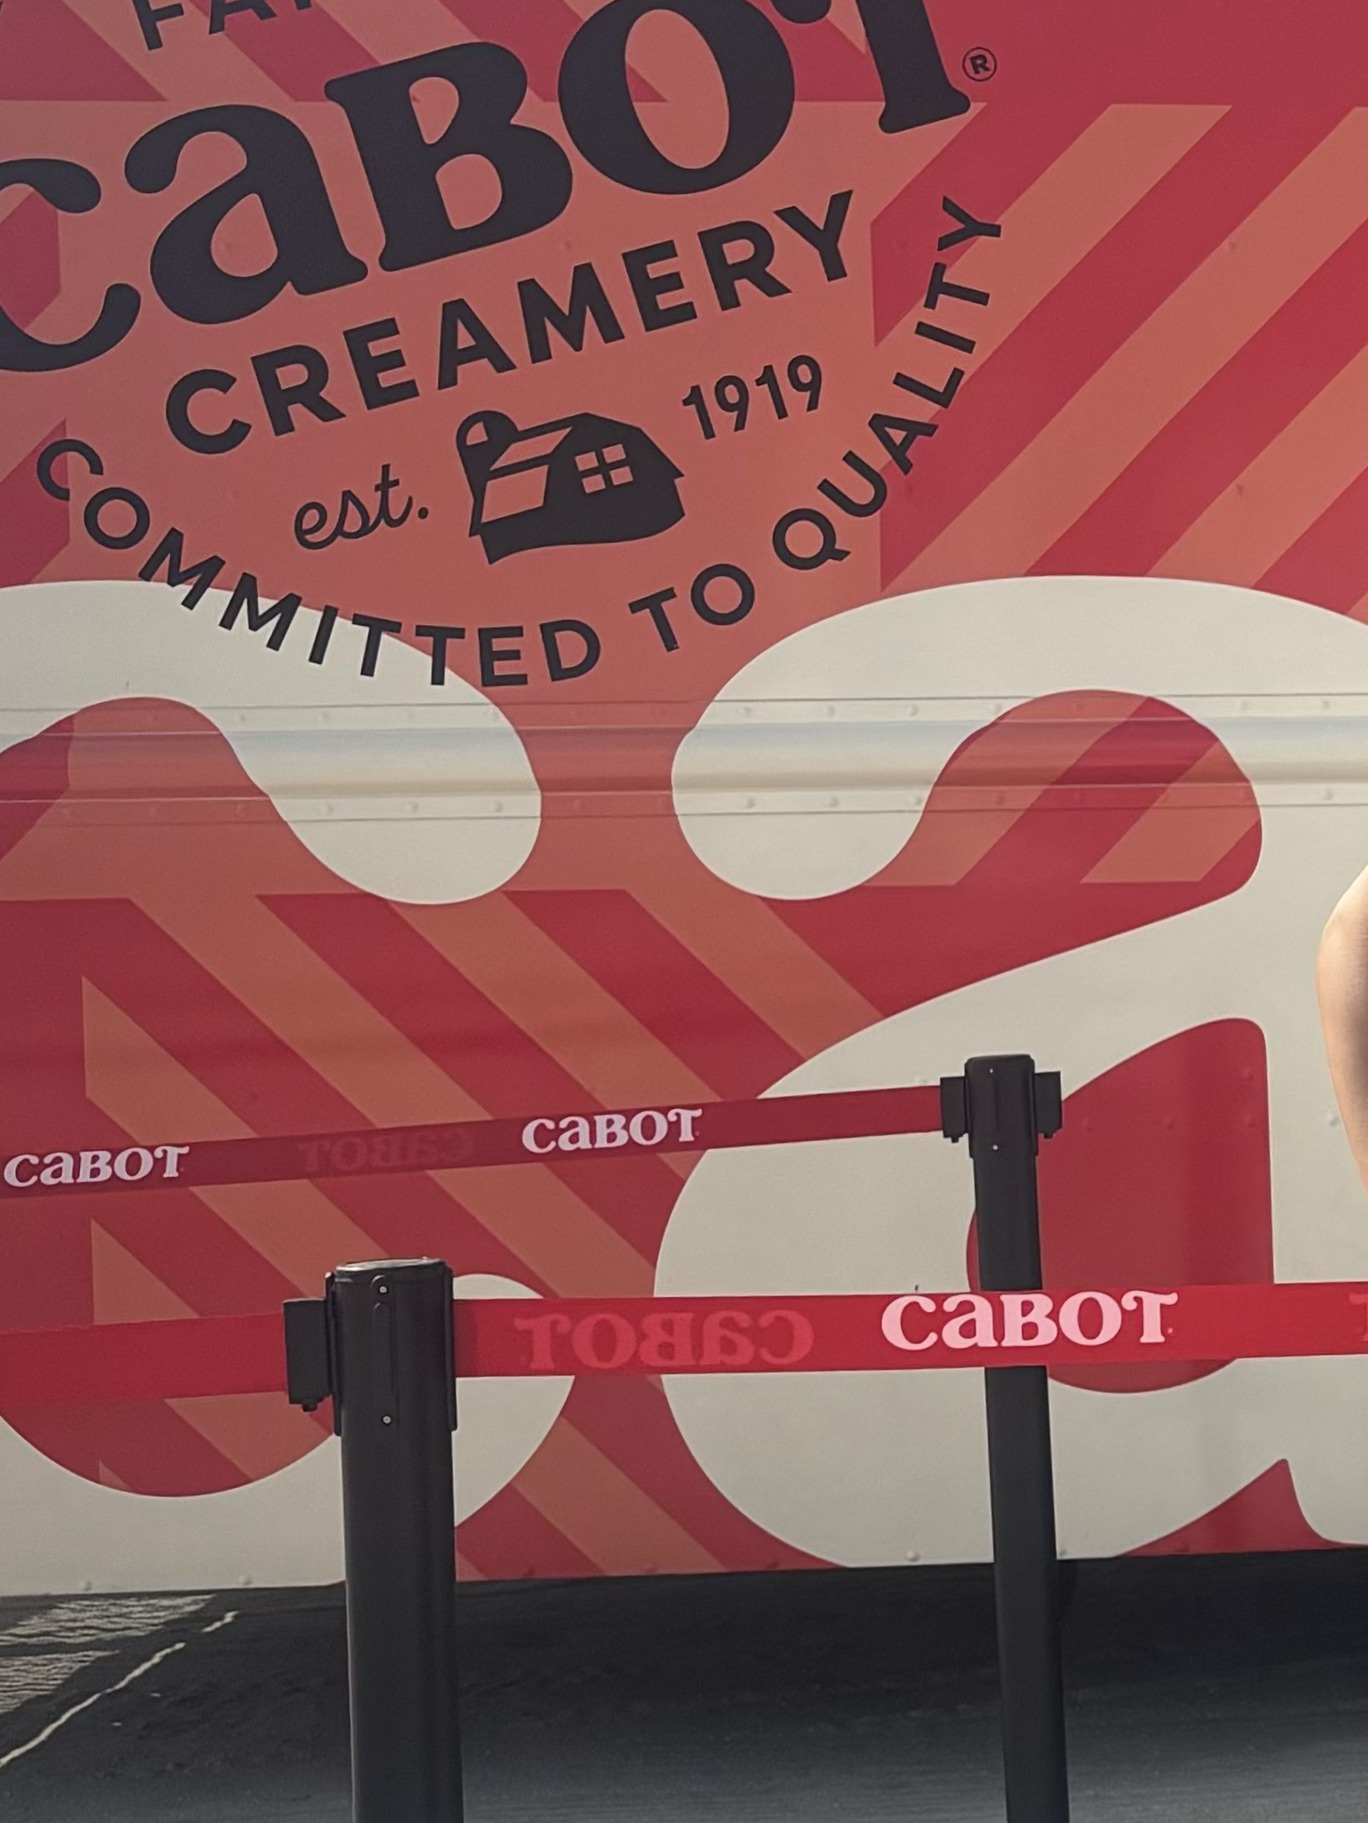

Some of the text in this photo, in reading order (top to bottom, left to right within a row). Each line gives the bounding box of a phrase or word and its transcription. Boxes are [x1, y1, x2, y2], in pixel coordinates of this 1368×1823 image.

[36, 196, 1002, 688] COMMITTED TO QUALITY
[165, 189, 855, 454] CREAMERY
[295, 355, 823, 550] est. 1919
